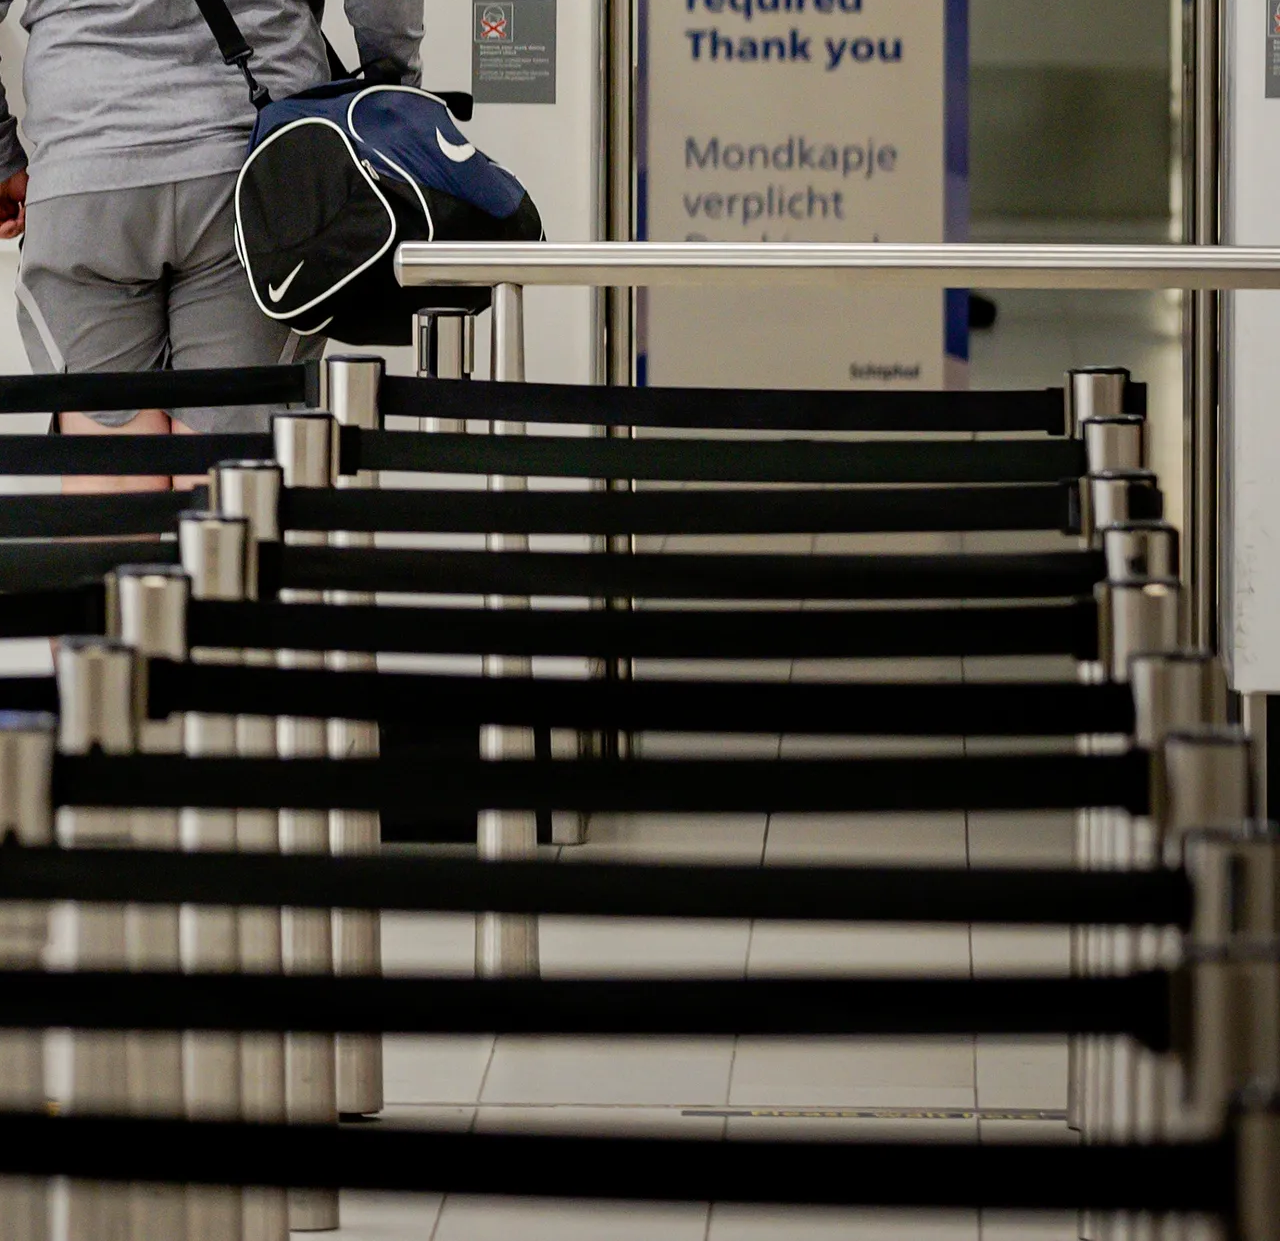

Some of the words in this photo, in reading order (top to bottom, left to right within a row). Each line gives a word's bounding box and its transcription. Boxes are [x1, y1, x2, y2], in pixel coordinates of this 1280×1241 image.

[685, 30, 812, 64] Thank
[824, 33, 903, 71] you
[684, 136, 898, 178] Mondkapje
[683, 186, 844, 225] verplicht
